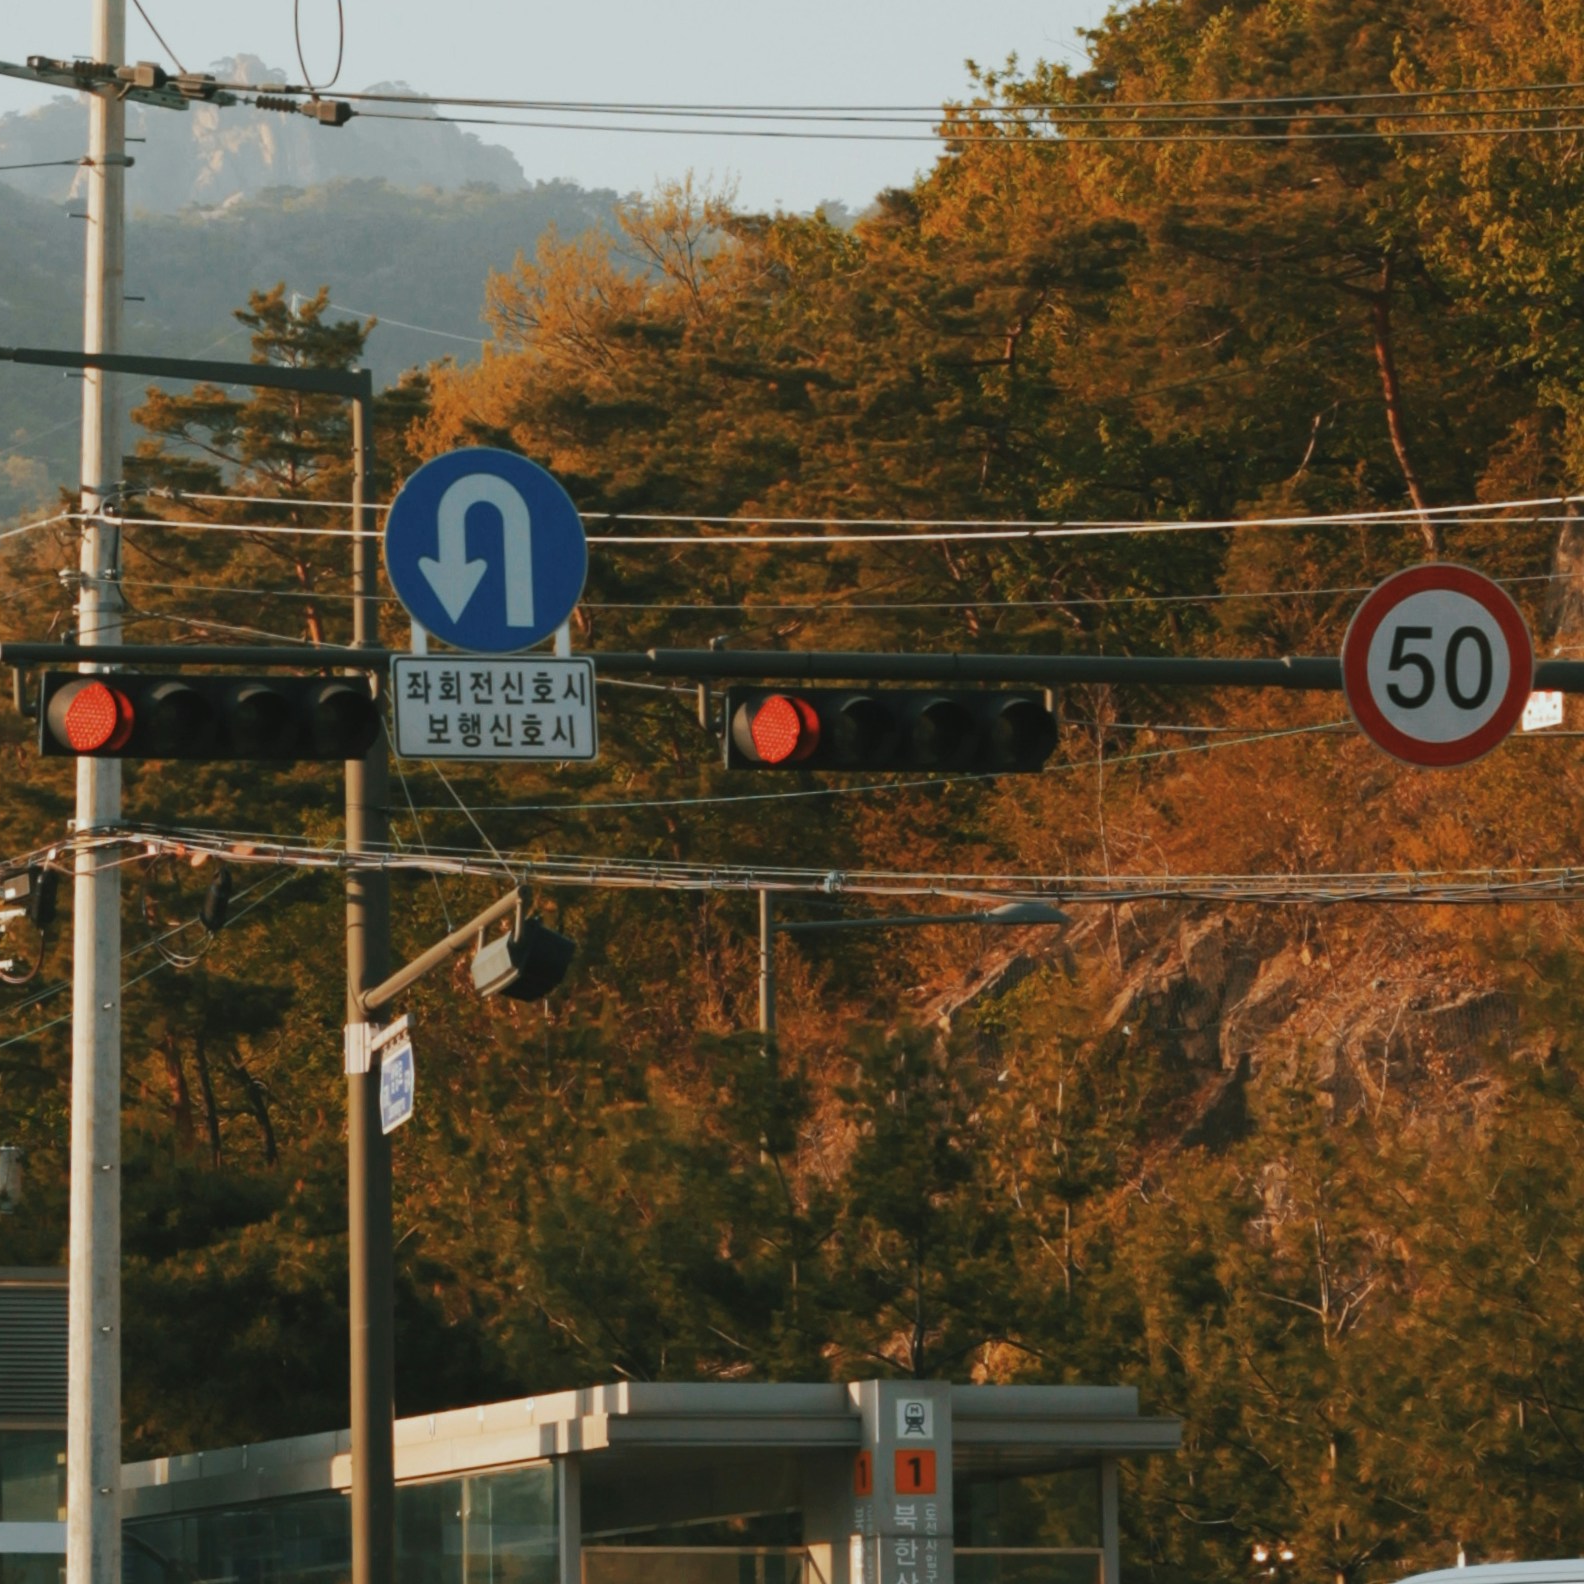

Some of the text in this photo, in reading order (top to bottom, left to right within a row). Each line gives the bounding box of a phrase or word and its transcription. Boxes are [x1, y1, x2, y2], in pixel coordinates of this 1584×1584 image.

[1386, 626, 1493, 710] 50
[427, 712, 575, 748] 보행신호시
[907, 1456, 921, 1487] 1
